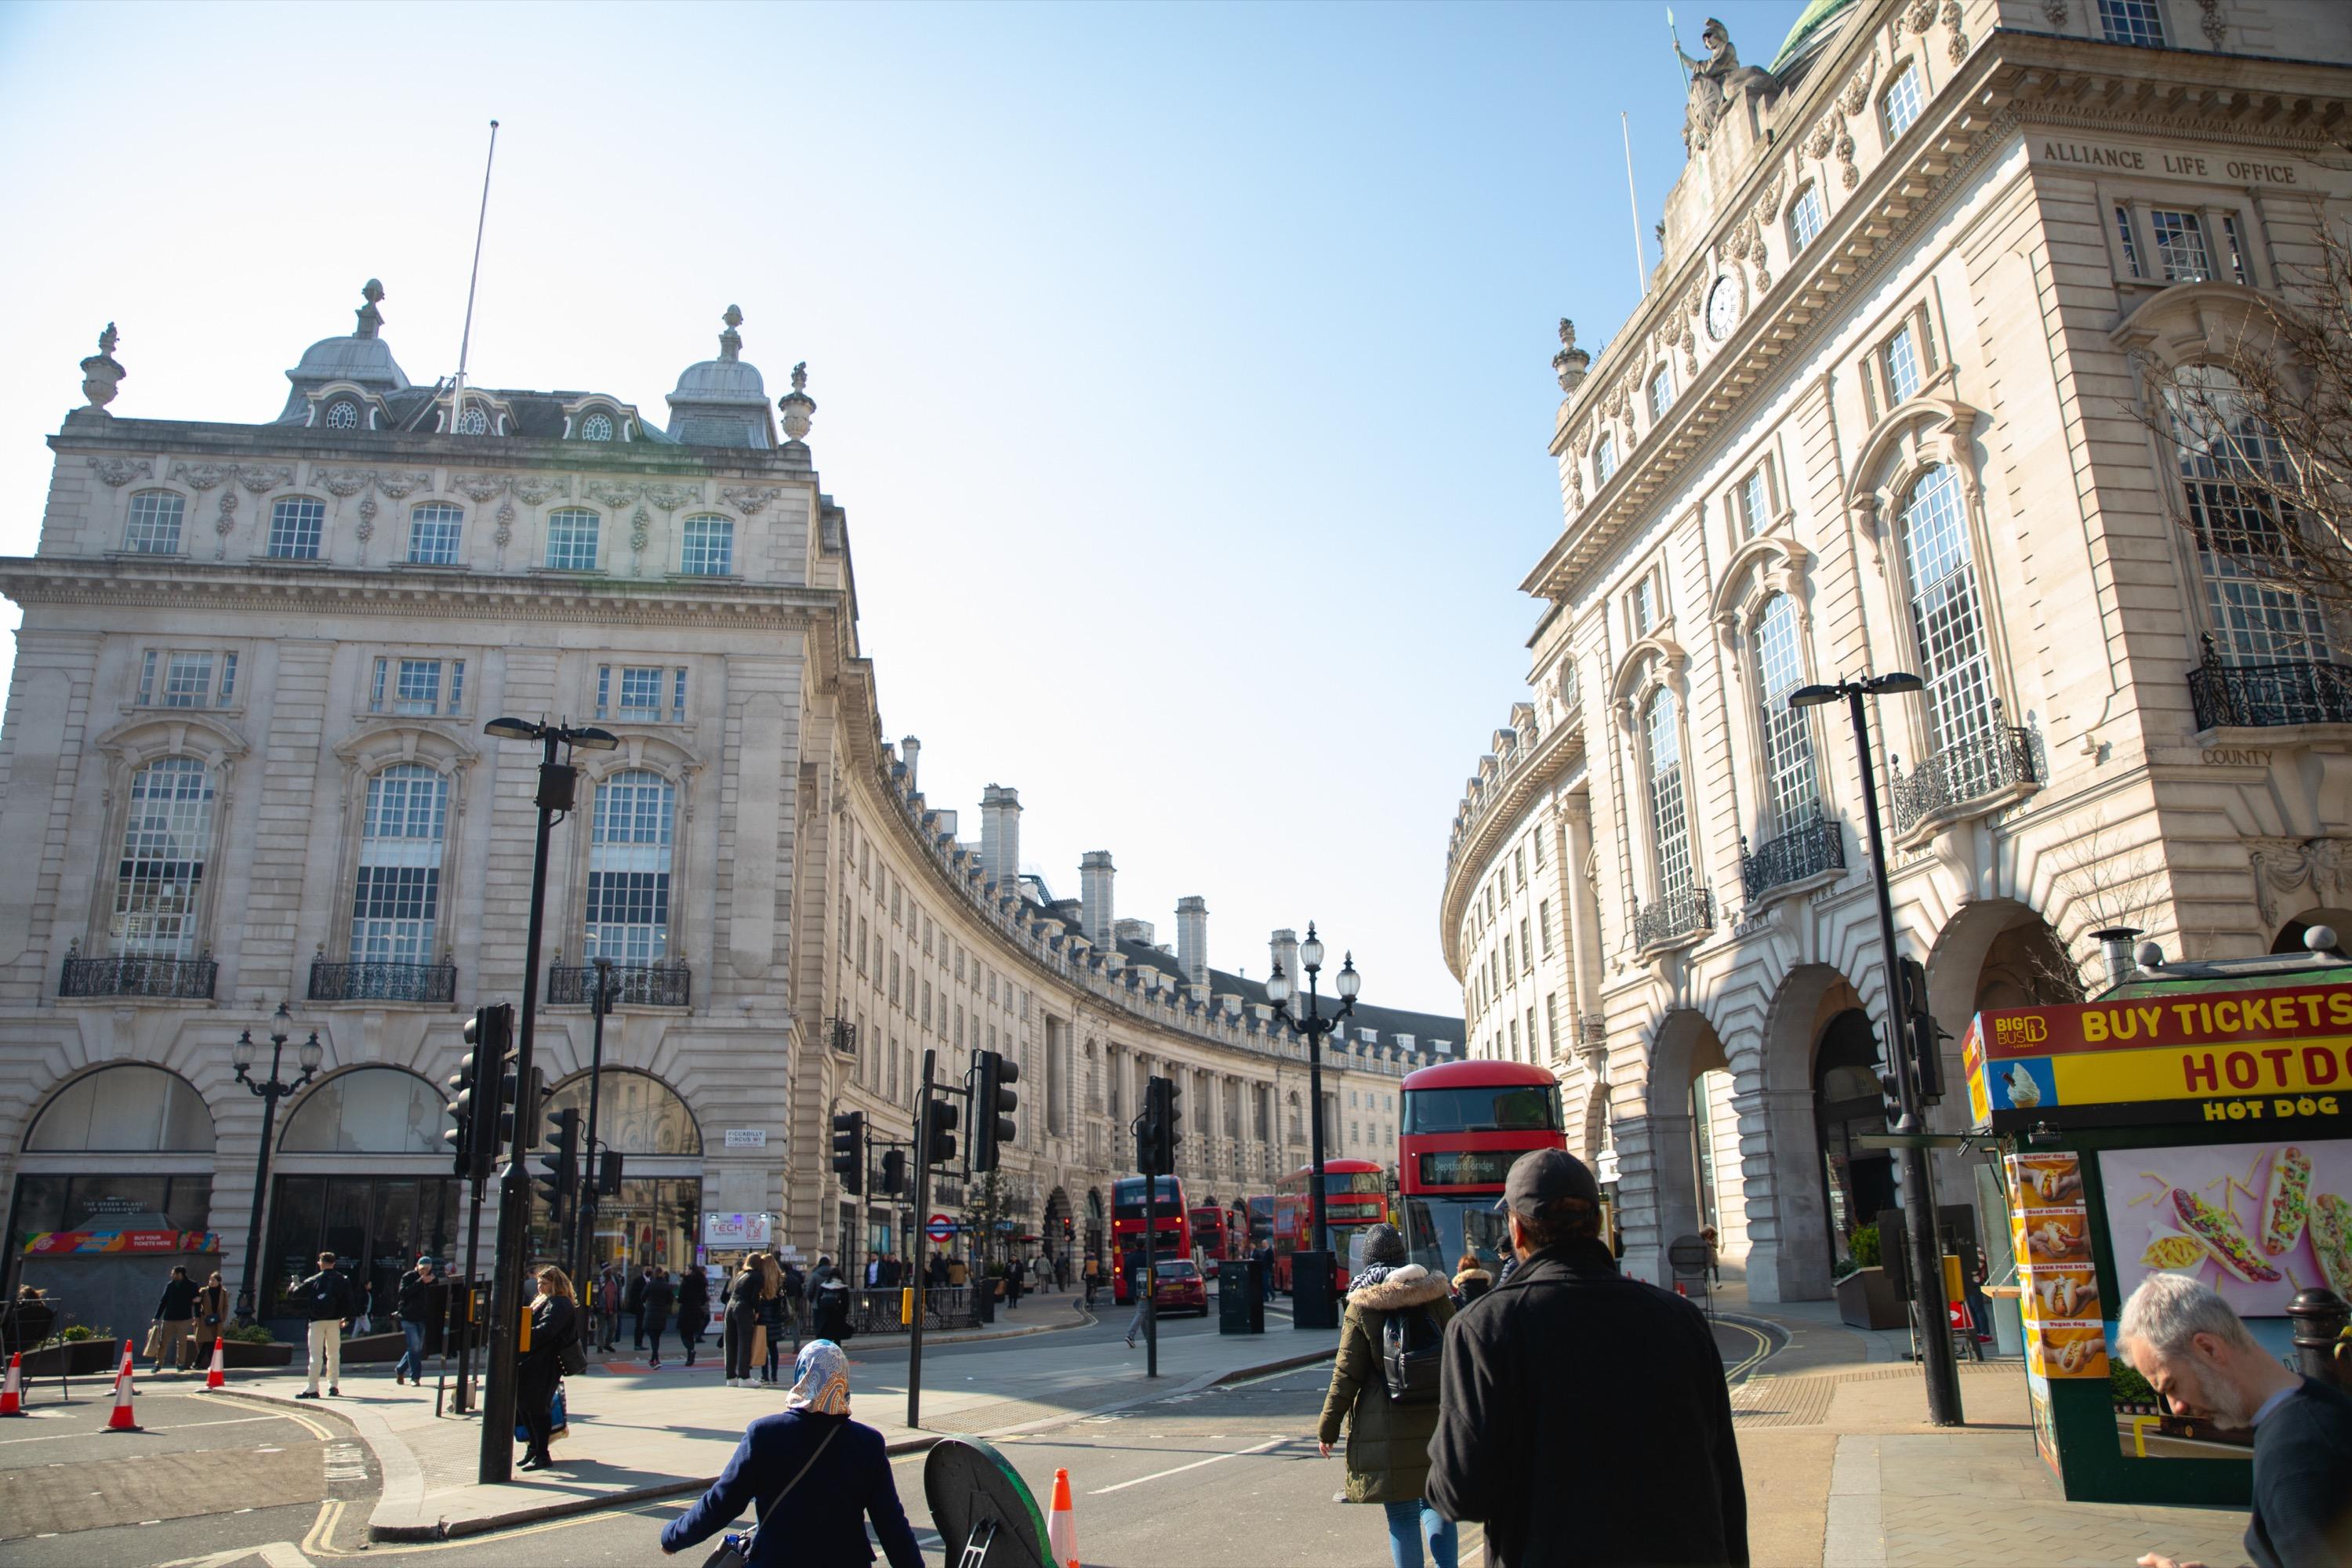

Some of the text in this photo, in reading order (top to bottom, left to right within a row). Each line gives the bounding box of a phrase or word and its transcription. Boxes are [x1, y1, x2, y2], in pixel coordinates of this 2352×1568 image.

[2045, 143, 2296, 184] ALLIANCE LIFE OFFICE
[2202, 749, 2272, 766] COUNTY
[1734, 907, 1770, 937] COUNT
[1807, 882, 1837, 906] FIRE
[1995, 1017, 2024, 1032] BIG
[2082, 993, 2352, 1042] BUY TICKETS
[1997, 1031, 2026, 1045] BUS
[2183, 1047, 2352, 1092] HOTD
[2203, 1097, 2339, 1121] HOT DOG
[1435, 1160, 1494, 1173] Deptford Bridge
